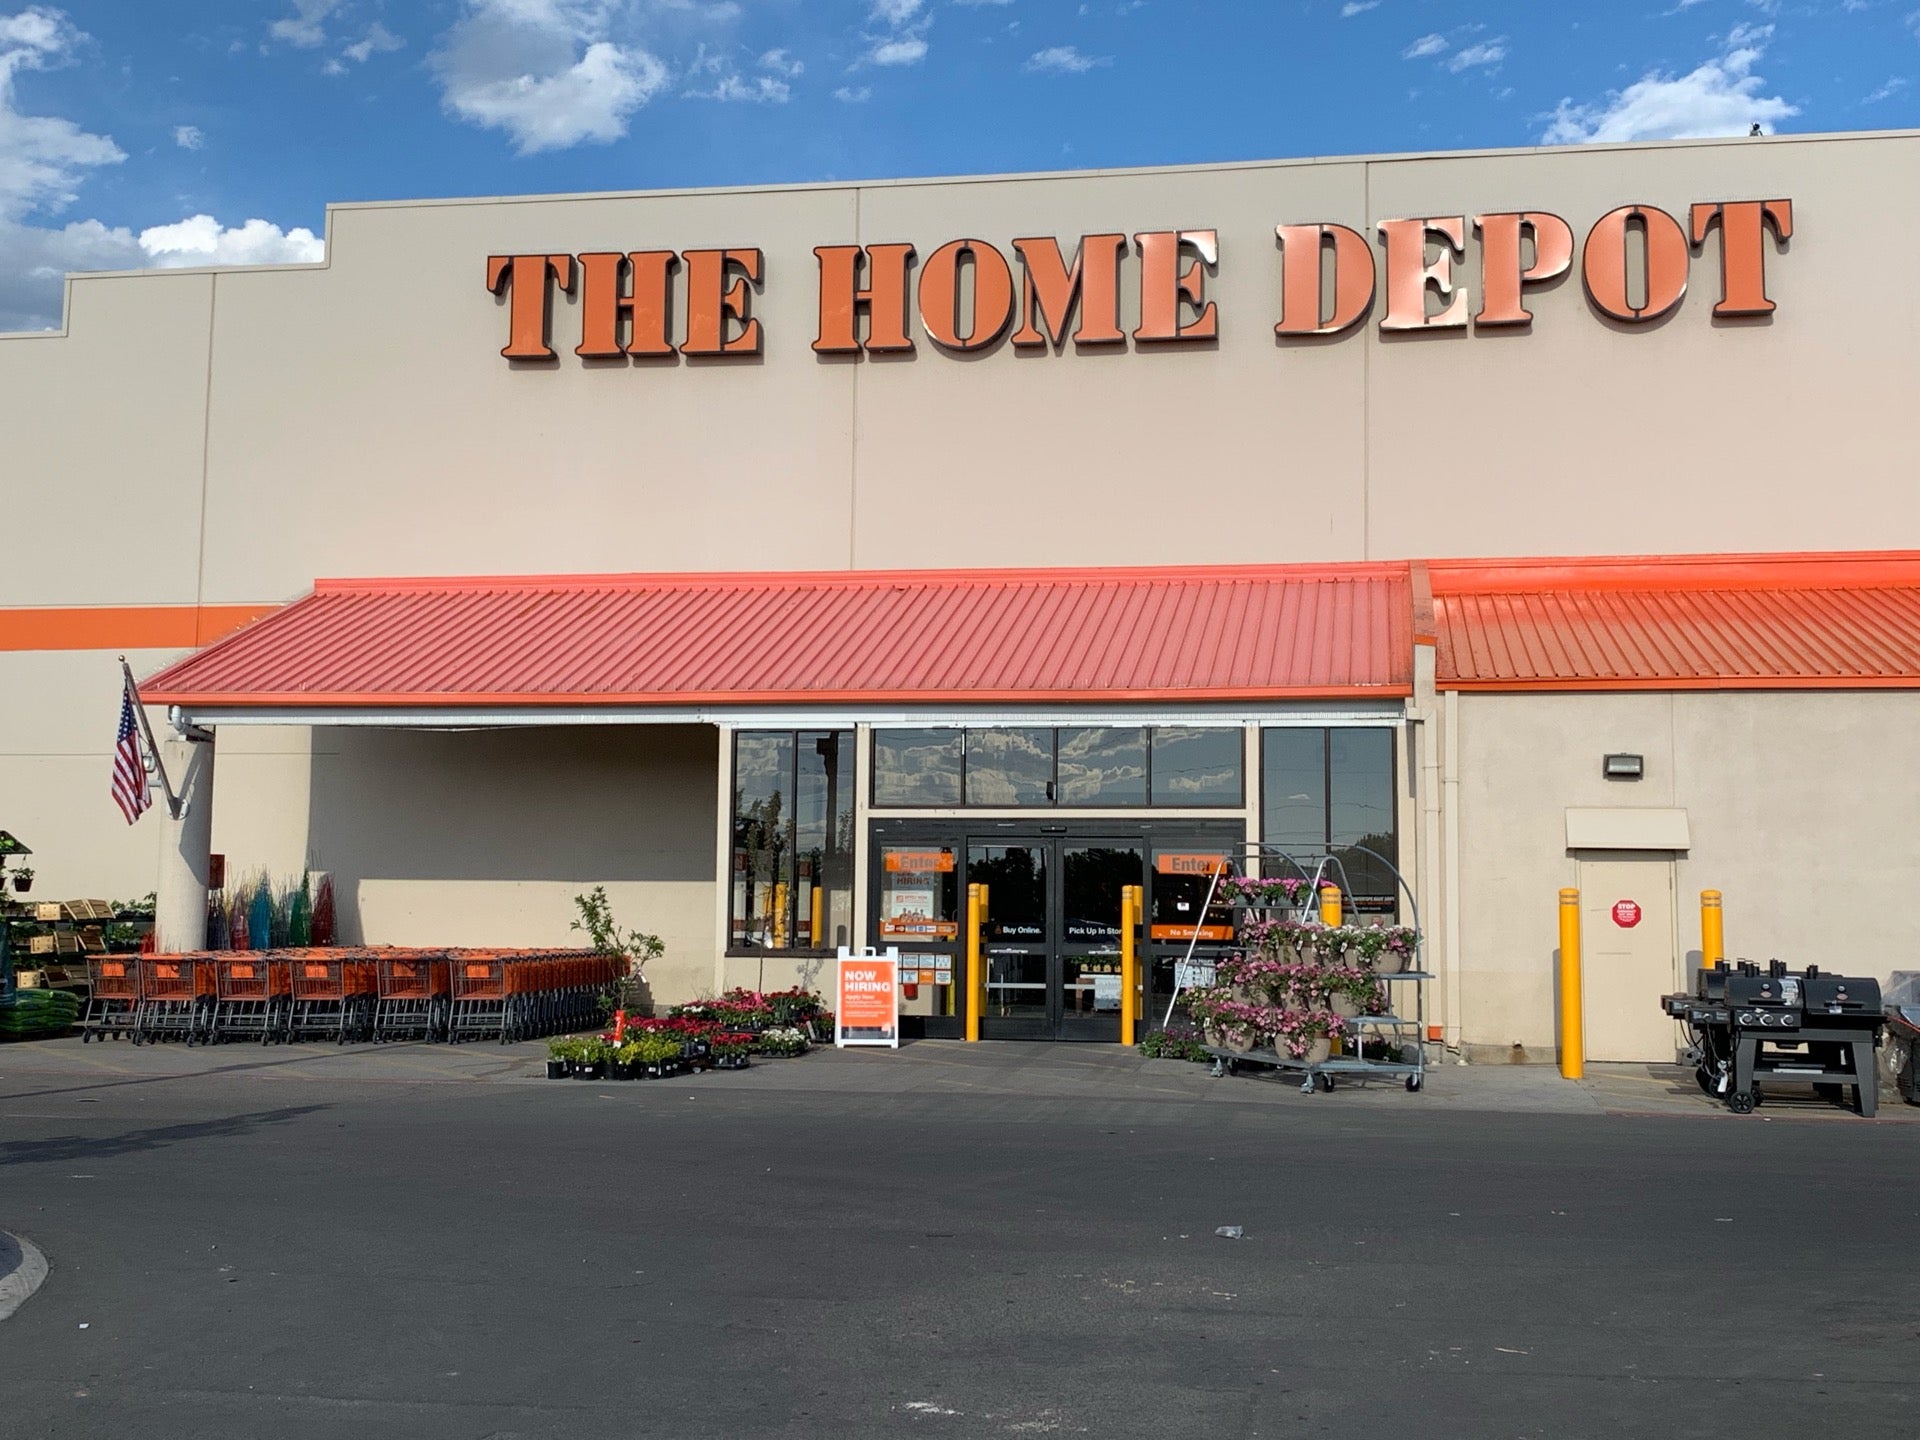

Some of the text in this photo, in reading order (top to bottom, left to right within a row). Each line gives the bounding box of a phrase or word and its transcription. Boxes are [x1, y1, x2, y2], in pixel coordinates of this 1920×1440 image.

[487, 199, 1793, 360] THE HOME DEPOT
[900, 856, 939, 868] Enter
[1172, 857, 1212, 872] Enter
[1003, 926, 1042, 935] Buy Online.
[1069, 927, 1122, 936] Pick Up In Stor
[845, 970, 877, 981] NOW
[845, 982, 891, 992] HIRING
